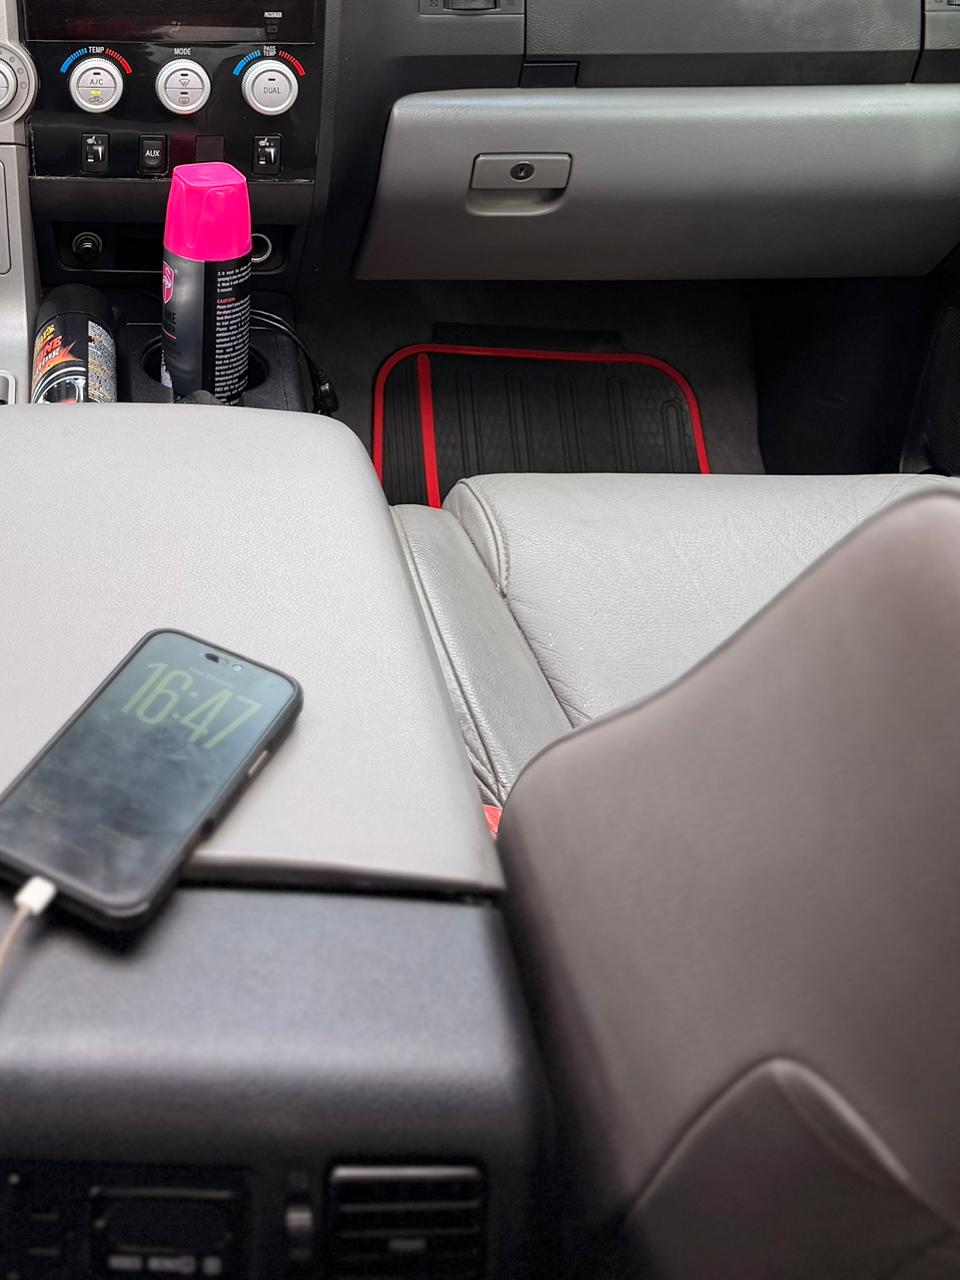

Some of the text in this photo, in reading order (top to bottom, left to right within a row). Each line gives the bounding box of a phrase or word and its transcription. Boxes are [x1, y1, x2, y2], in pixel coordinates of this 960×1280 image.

[263, 86, 281, 94] DUAL
[145, 149, 160, 157] AUX
[121, 662, 264, 750] 16:47
